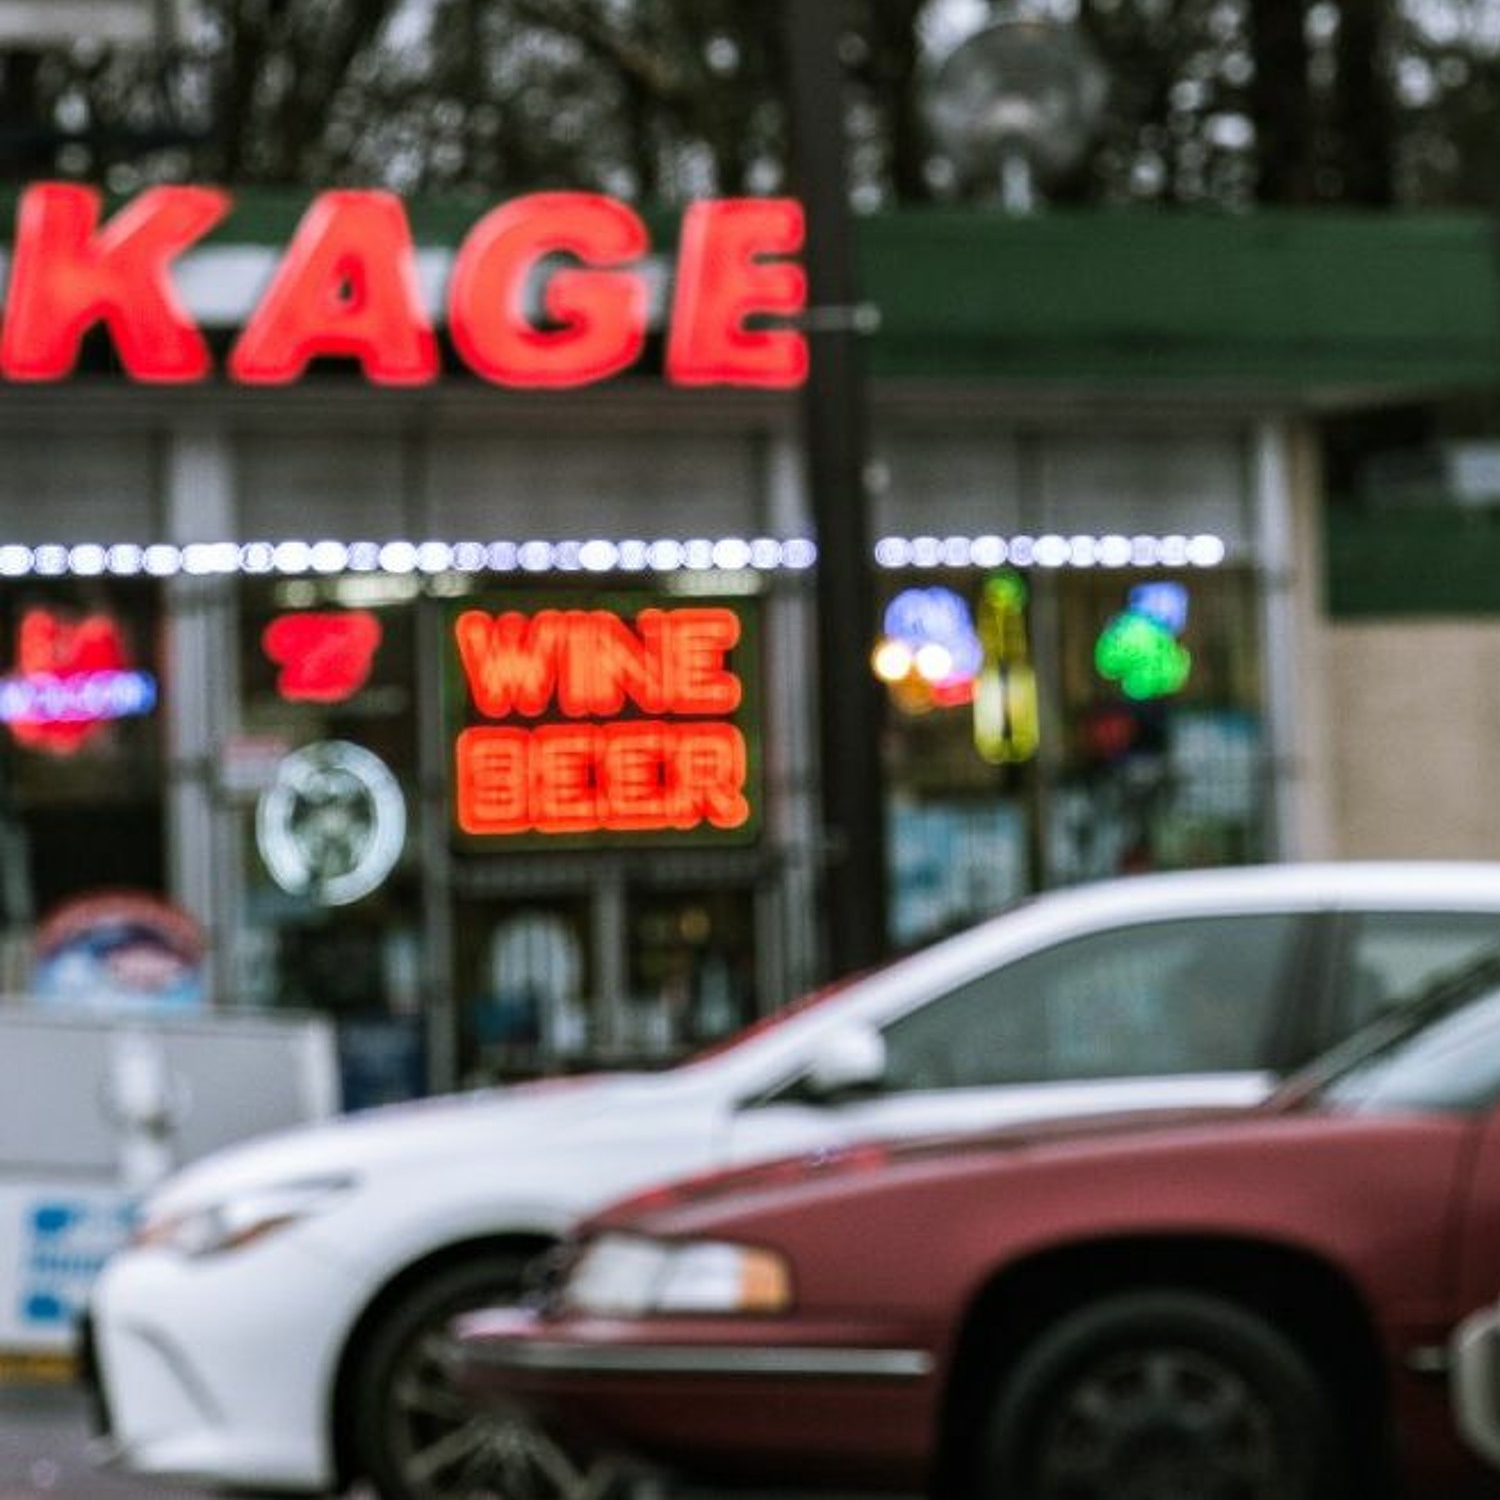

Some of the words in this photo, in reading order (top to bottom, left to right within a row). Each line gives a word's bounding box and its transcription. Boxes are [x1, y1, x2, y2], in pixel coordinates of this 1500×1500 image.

[1, 181, 810, 389] KAGE
[455, 608, 742, 717] WINE
[456, 720, 749, 835] BEER
